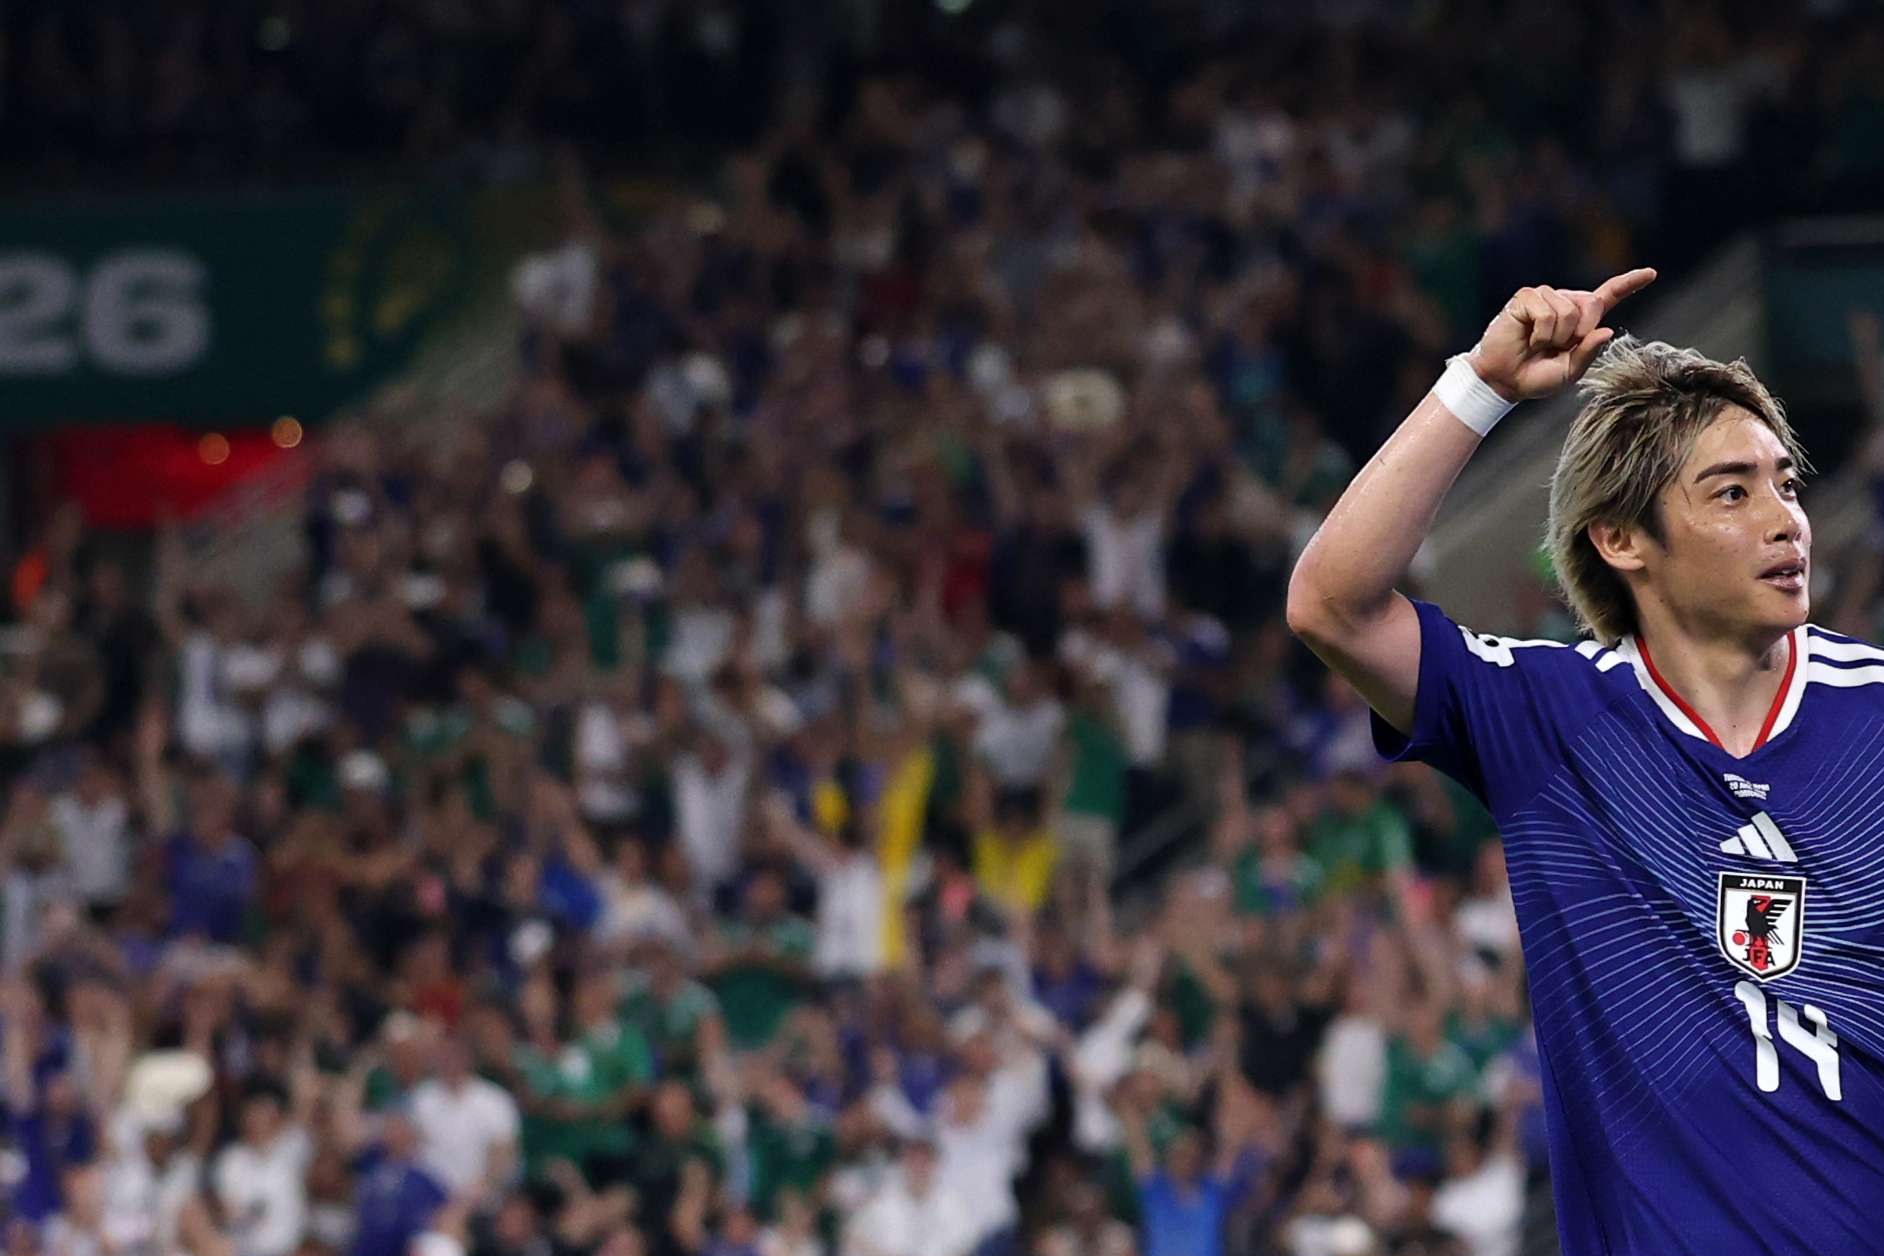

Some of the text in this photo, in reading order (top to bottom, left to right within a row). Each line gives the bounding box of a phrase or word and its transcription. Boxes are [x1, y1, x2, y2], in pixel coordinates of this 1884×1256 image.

[1739, 878, 1784, 890] JAPAN
[1742, 948, 1776, 966] JFA
[1734, 980, 1843, 1102] 14
